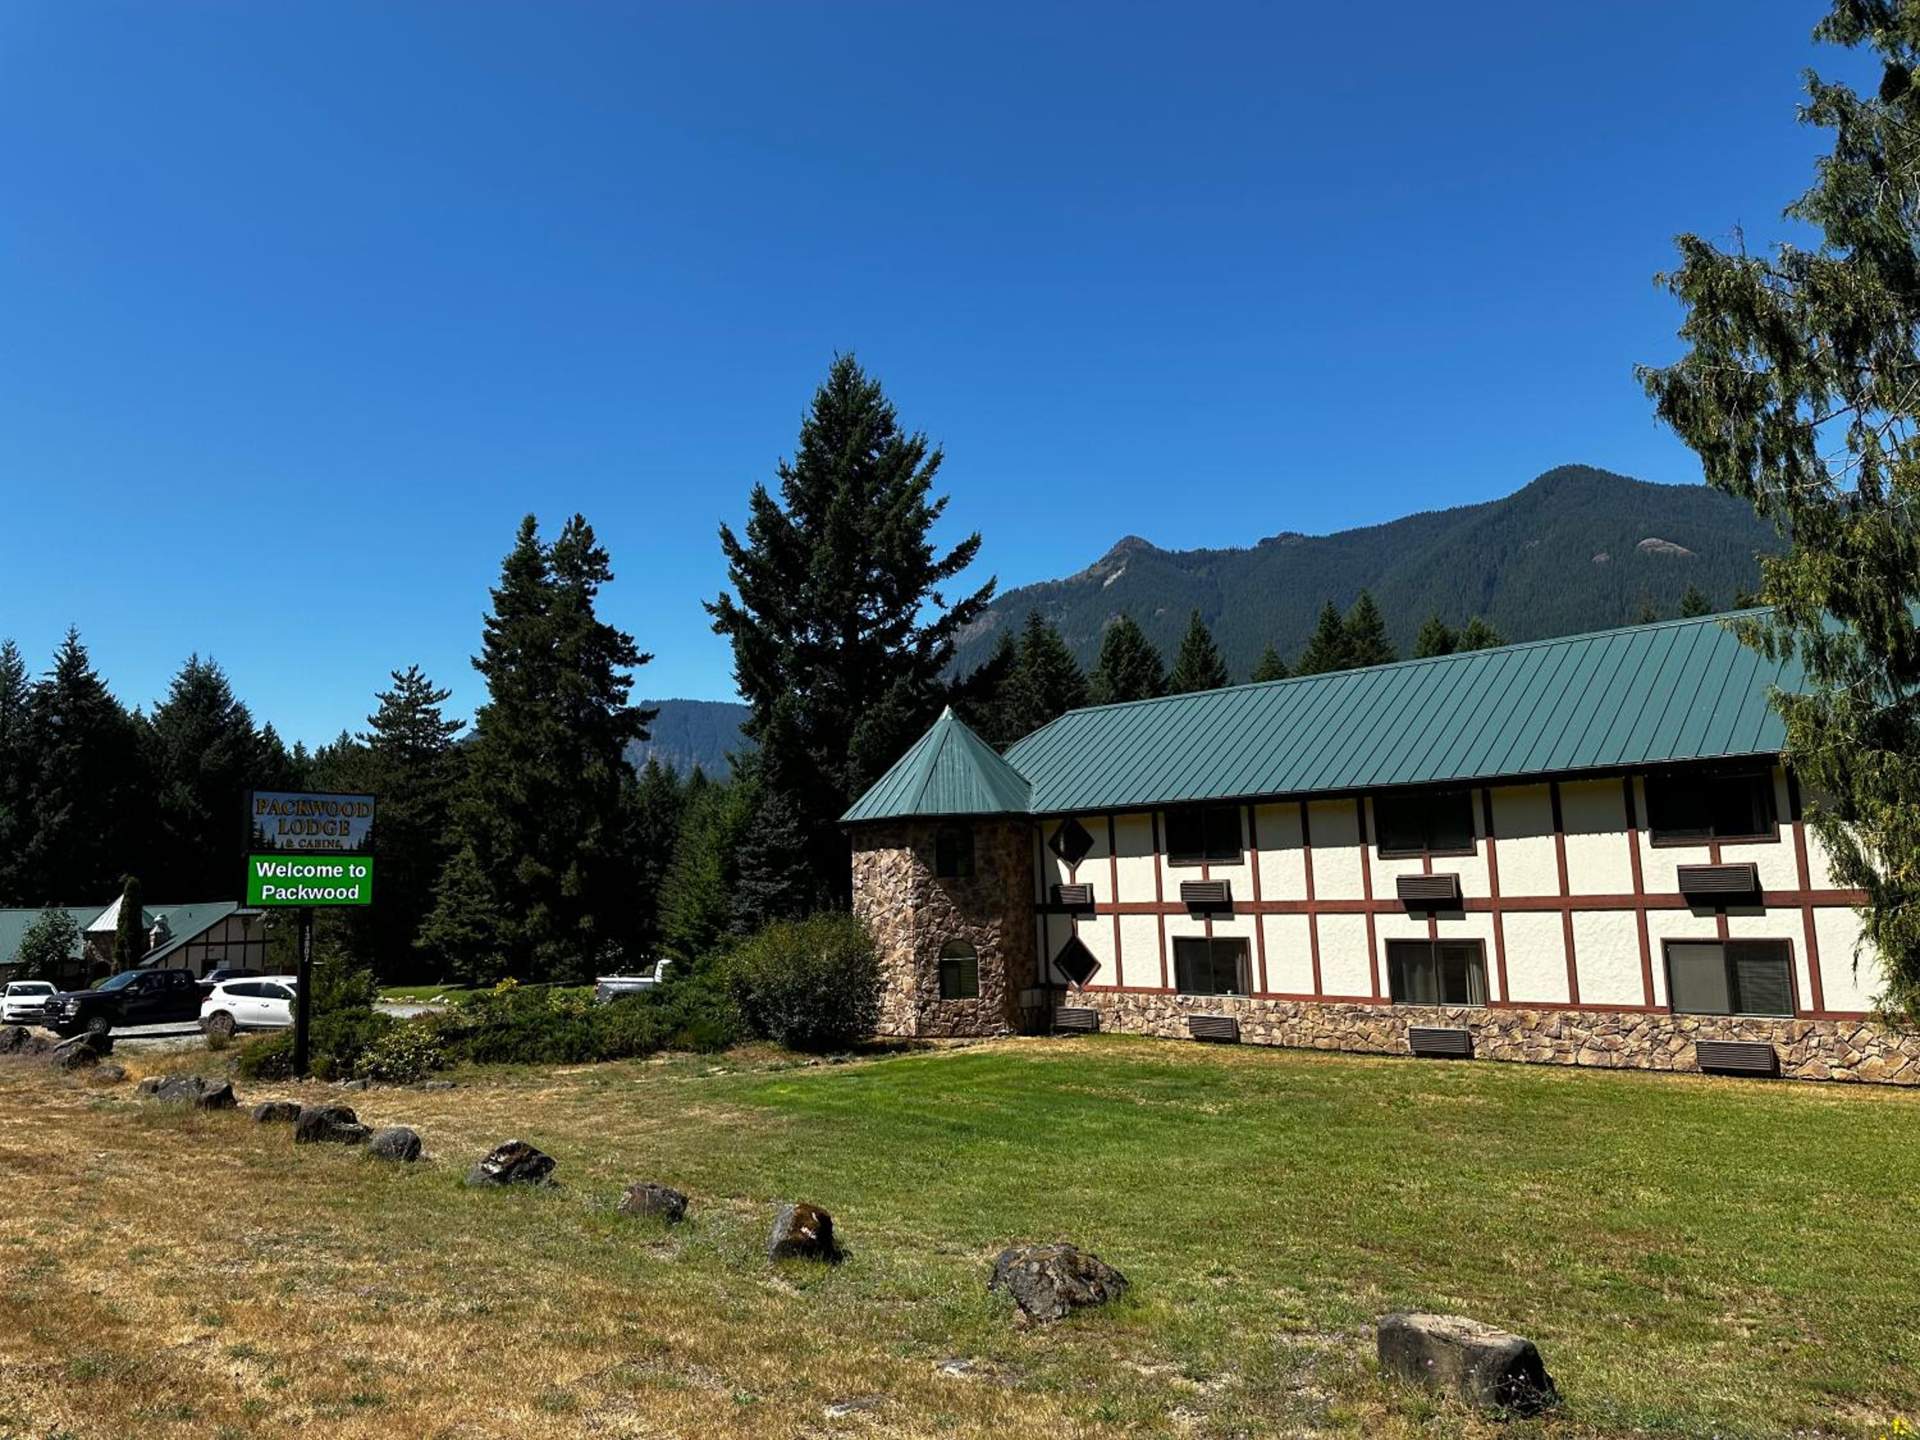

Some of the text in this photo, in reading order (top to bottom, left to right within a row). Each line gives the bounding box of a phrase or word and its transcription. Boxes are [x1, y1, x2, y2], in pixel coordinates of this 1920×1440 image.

[255, 798, 372, 818] PACKWOOD
[278, 817, 350, 836] LODGE
[256, 862, 367, 878] Welcome to
[261, 884, 359, 900] Packwood
